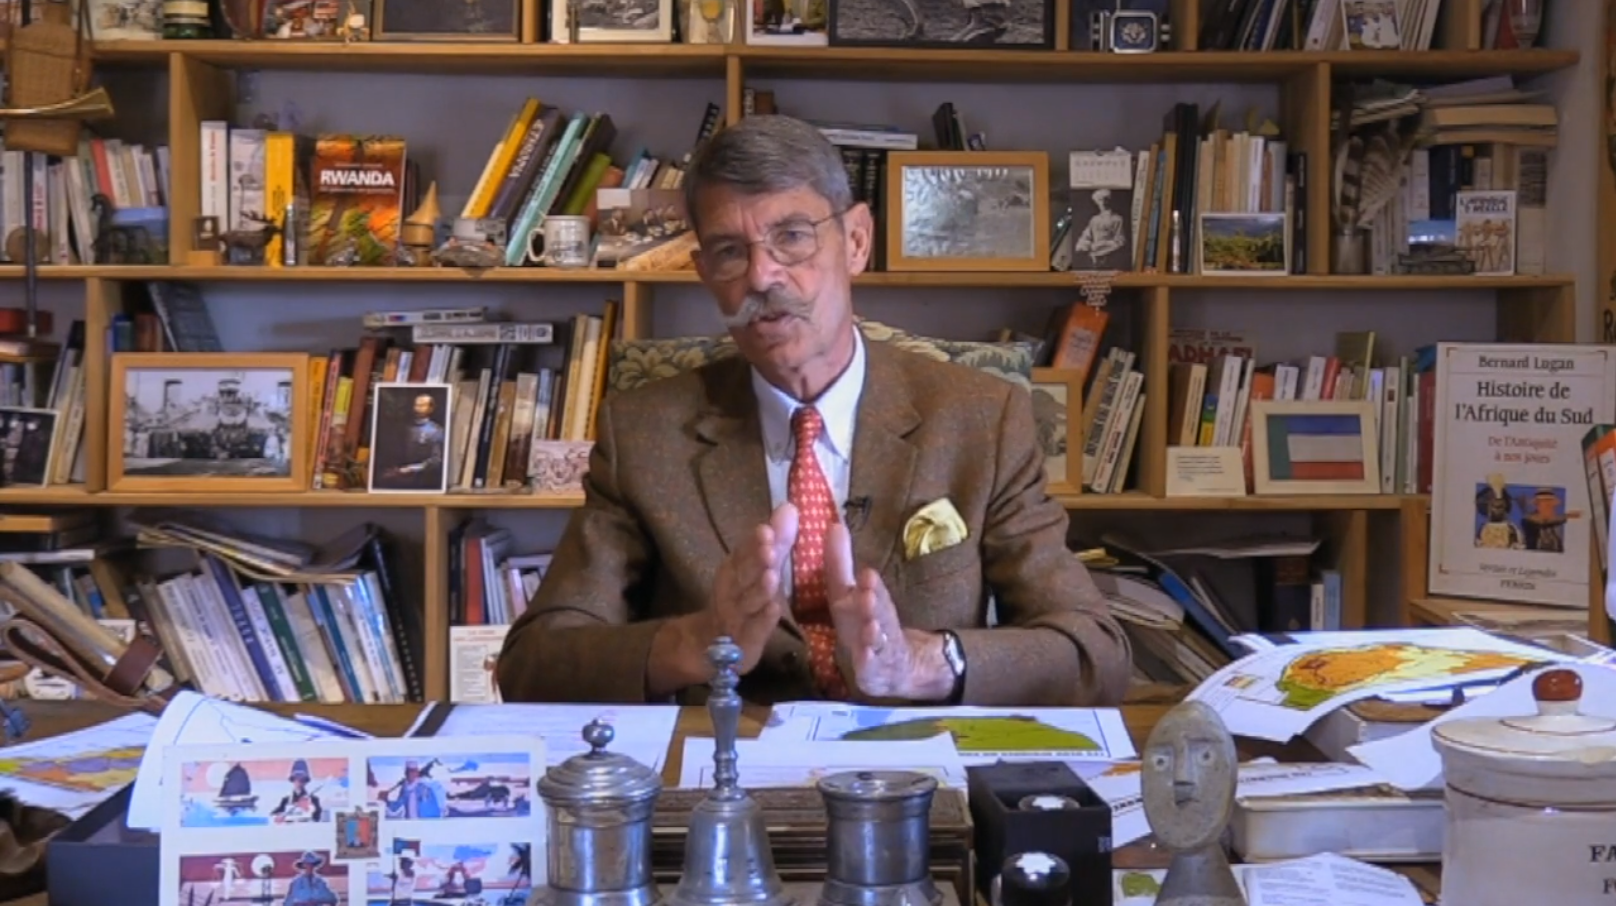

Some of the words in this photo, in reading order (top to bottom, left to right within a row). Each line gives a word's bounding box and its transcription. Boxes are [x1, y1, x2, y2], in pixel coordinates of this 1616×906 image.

[320, 169, 395, 187] RWANDA
[1478, 355, 1529, 369] Bernard
[1534, 356, 1575, 374] Lugan
[1476, 380, 1545, 399] Histoire
[1549, 381, 1571, 399] de
[1454, 403, 1529, 426] l'Afrique
[1534, 406, 1556, 423] du
[1560, 408, 1594, 425] Sud
[1488, 436, 1502, 447] De
[1524, 452, 1551, 464] jours
